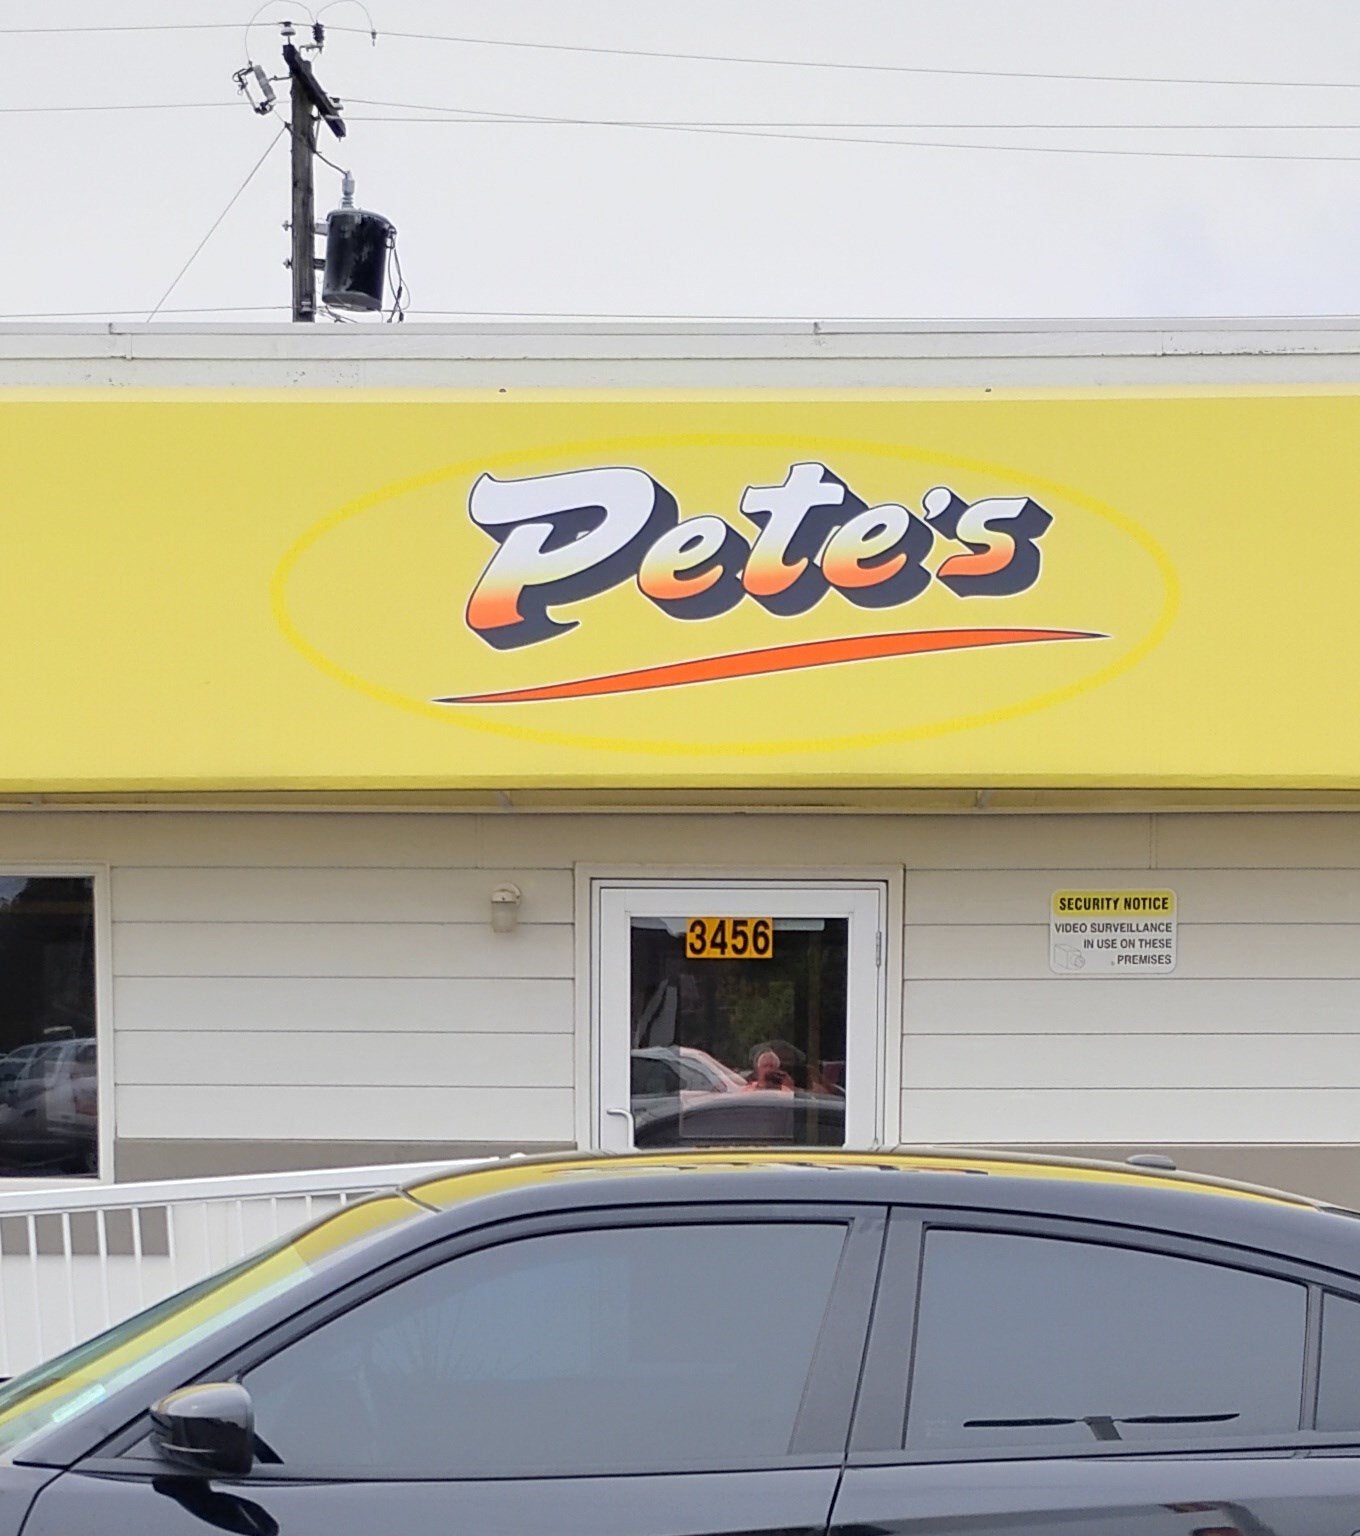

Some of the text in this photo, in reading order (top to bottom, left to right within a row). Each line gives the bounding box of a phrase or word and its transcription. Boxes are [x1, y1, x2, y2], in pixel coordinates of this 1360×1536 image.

[465, 461, 1054, 652] Pete's
[1059, 897, 1170, 911] SECURITY NOTICE
[1054, 922, 1173, 934] VIDEO SURVEILLANCE
[688, 918, 771, 957] 3456
[1083, 938, 1173, 950] IN USE ON THESE
[1116, 954, 1173, 966] PREMISES
